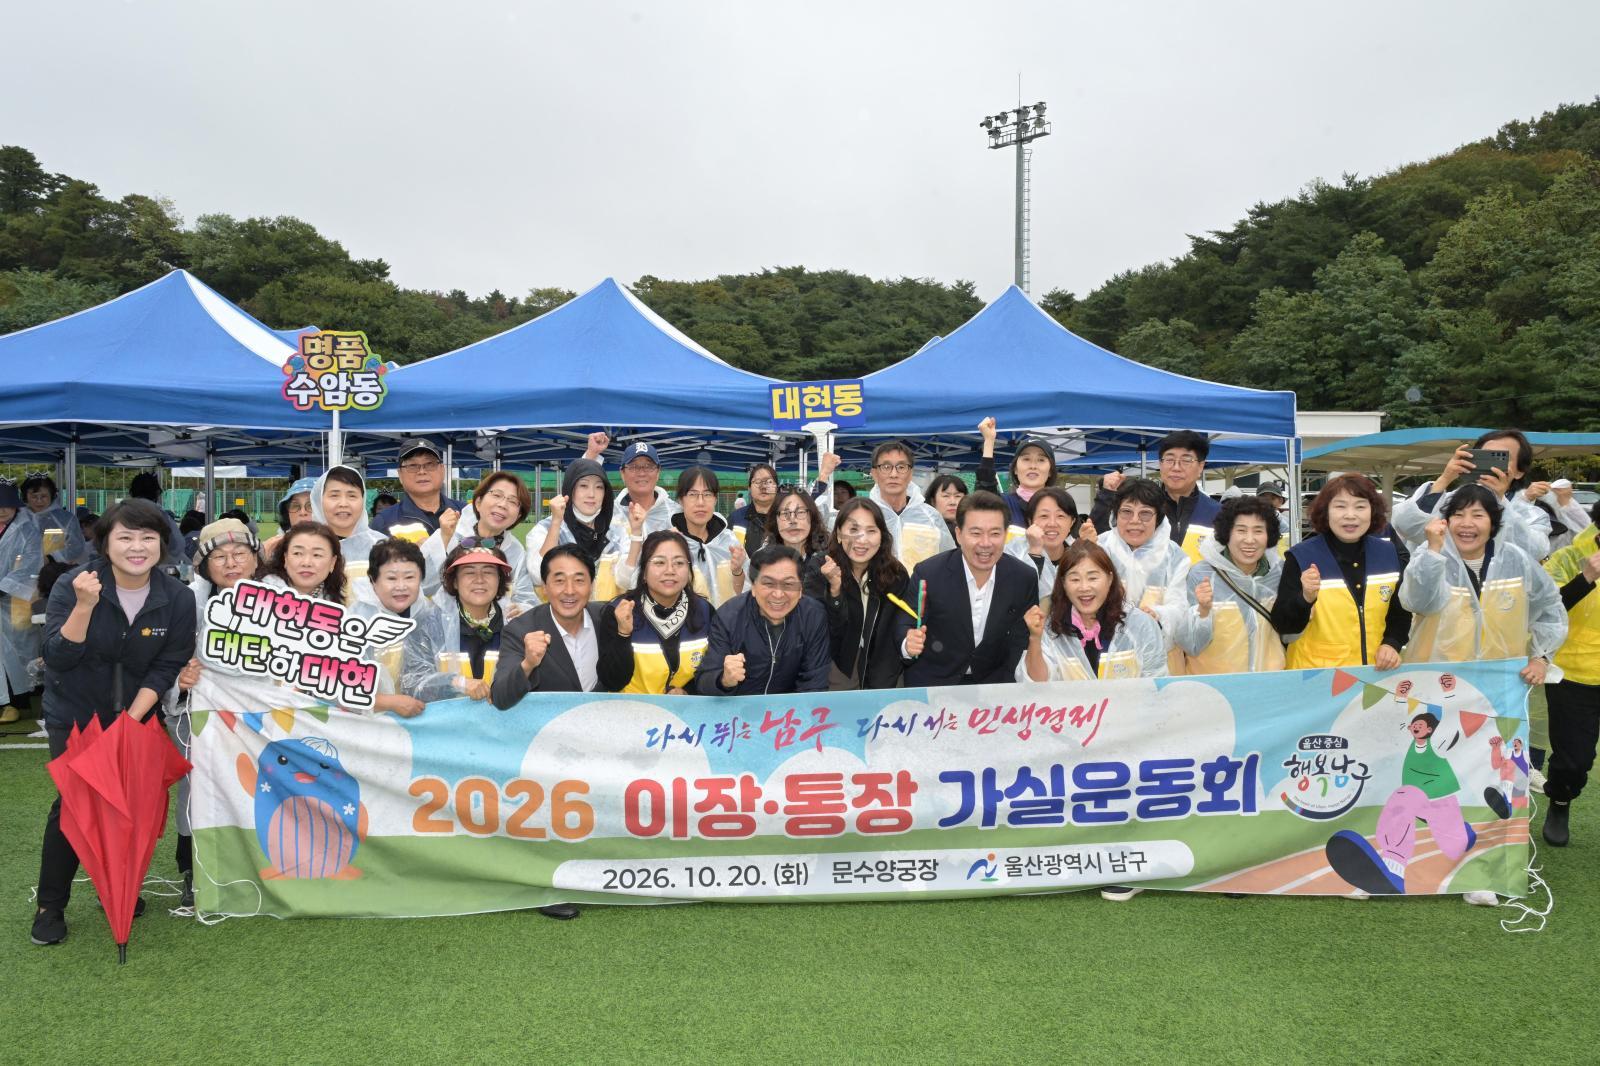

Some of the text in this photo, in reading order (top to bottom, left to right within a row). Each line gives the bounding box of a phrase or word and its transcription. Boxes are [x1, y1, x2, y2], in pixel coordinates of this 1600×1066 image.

[303, 335, 367, 370] 명품
[286, 372, 384, 406] 수암동
[772, 384, 863, 419] 대현동
[235, 583, 368, 655] 대현동은
[645, 698, 1109, 753] 다시 뛰는 남구 다시 서는 민생경제
[1302, 736, 1343, 749] 울산 중심
[408, 753, 1260, 838] 2026 이장·통장 가실운동회
[602, 858, 939, 890] 2026. 10. 20. (화) 문수양궁장
[1004, 851, 1148, 878] 울산광역시 남구
